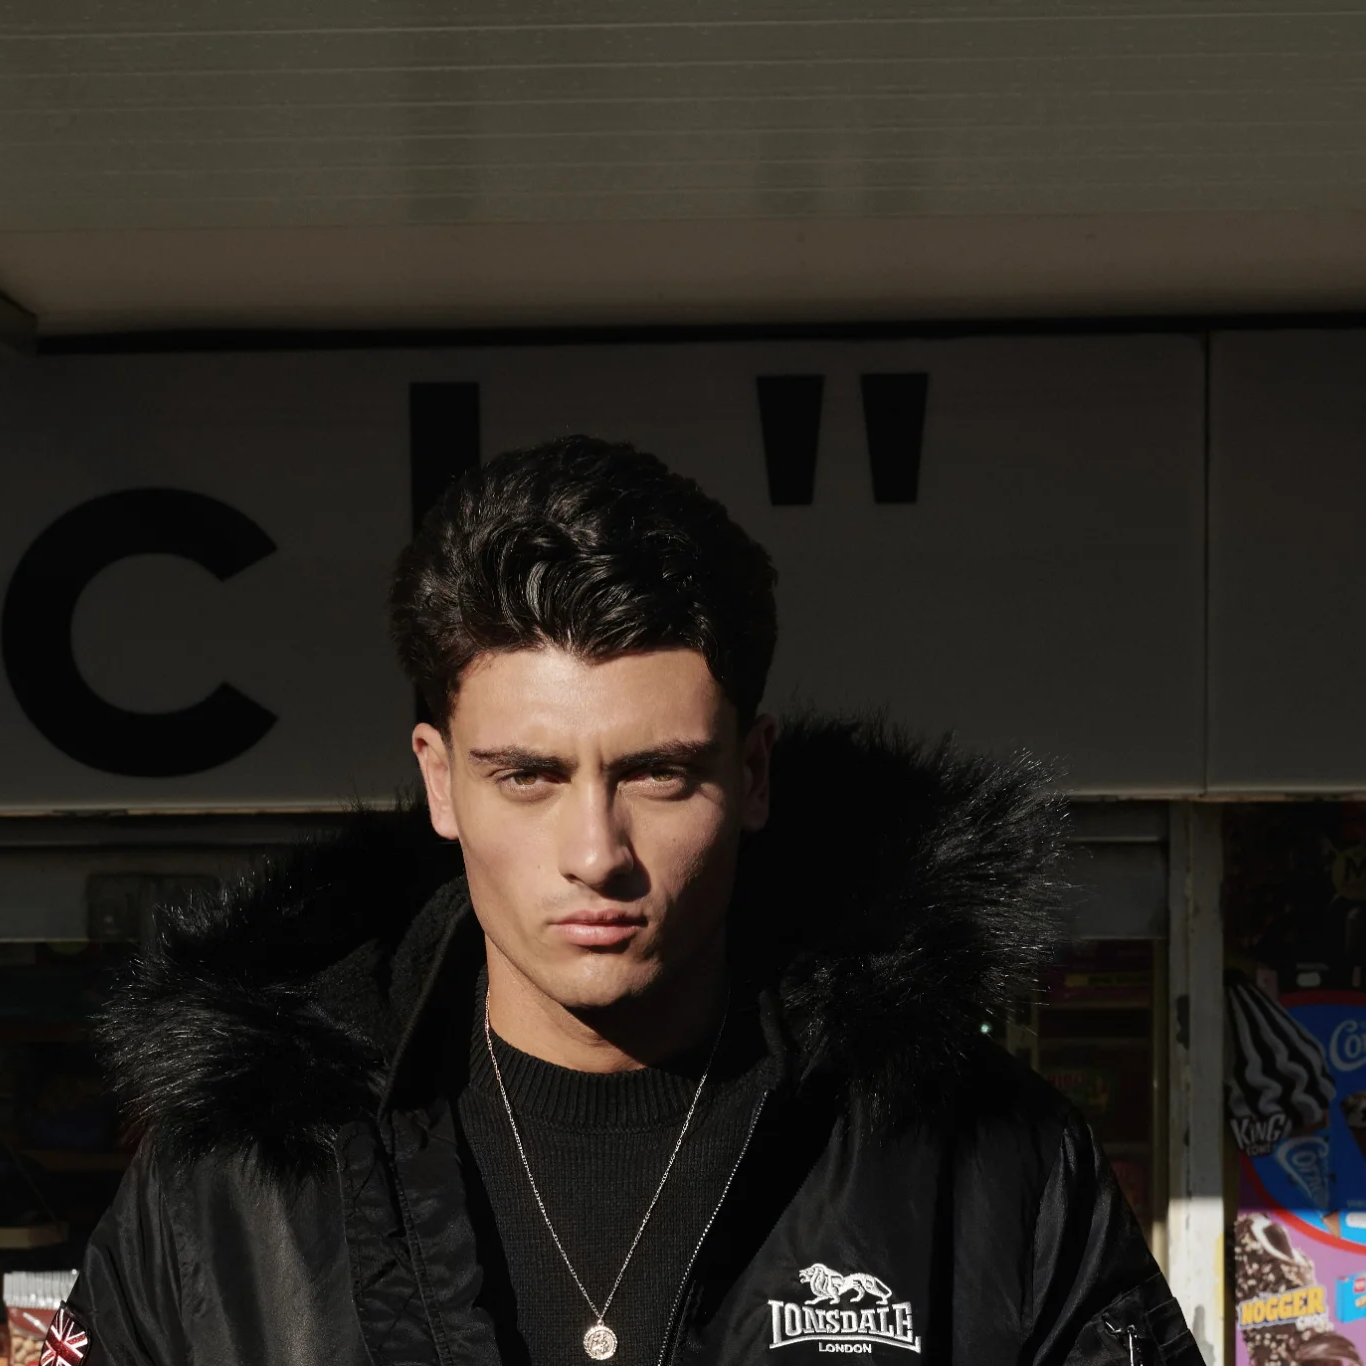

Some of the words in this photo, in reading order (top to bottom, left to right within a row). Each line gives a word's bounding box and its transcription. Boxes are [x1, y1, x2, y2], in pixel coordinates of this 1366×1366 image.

[767, 1299, 919, 1349] LONSDALE
[1240, 1286, 1325, 1326] NOGGER
[818, 1342, 872, 1354] LONDON
